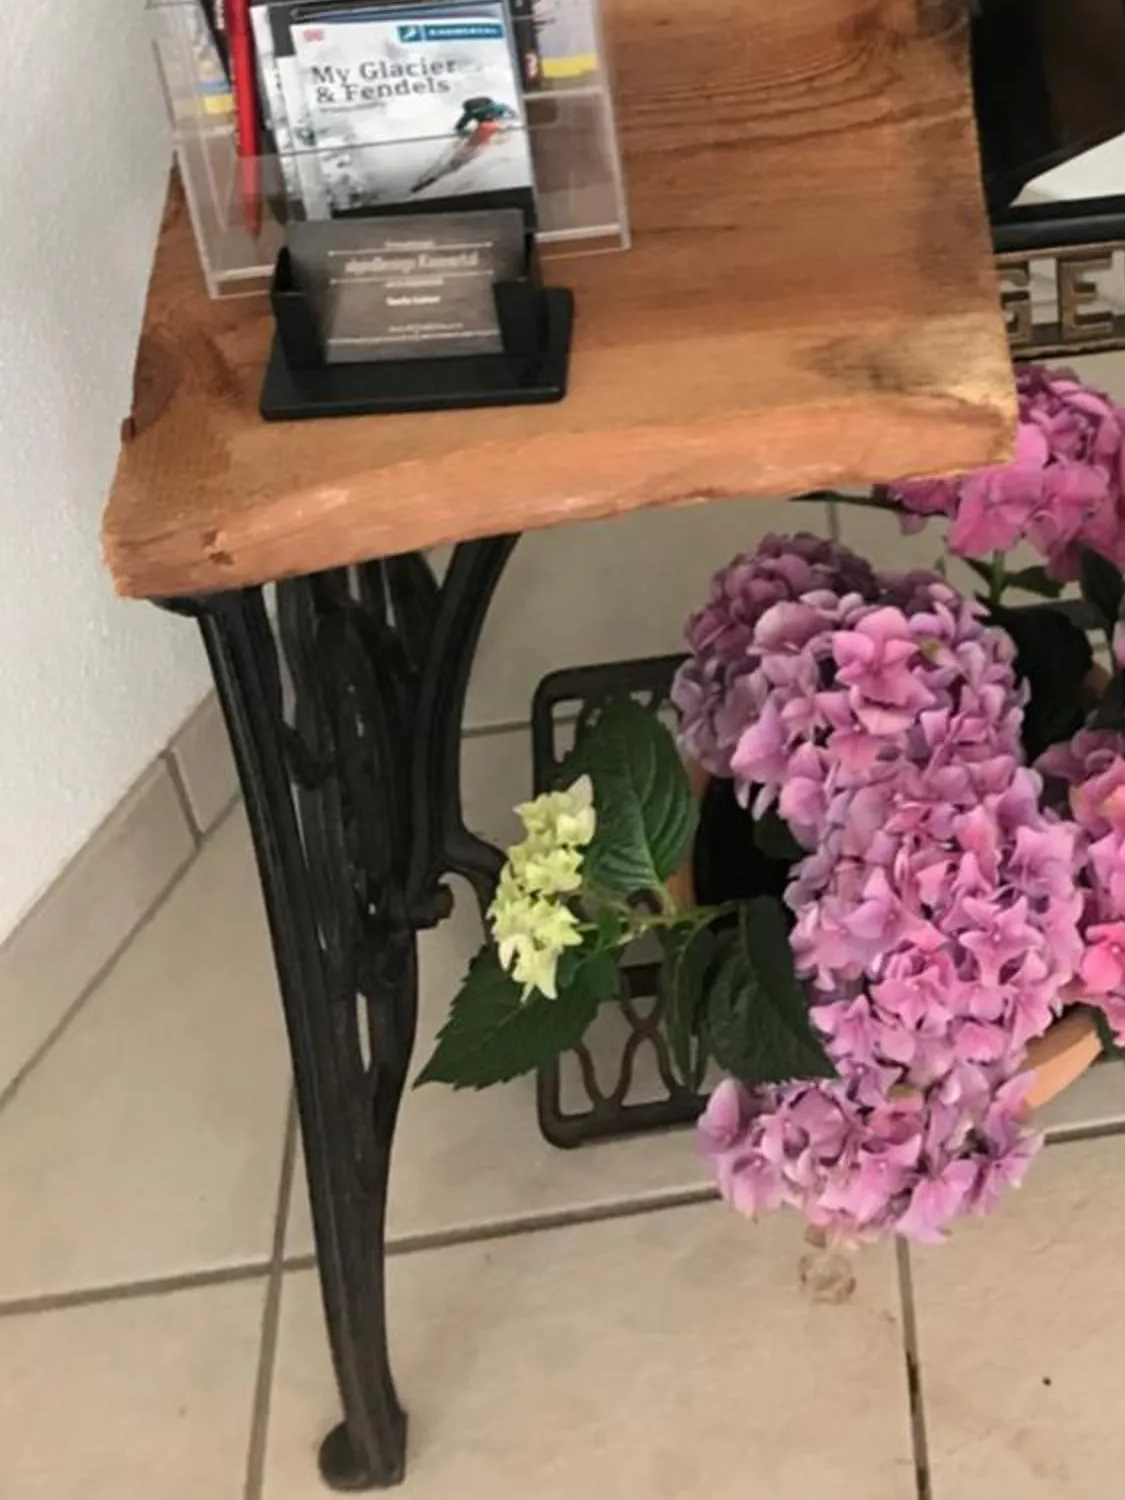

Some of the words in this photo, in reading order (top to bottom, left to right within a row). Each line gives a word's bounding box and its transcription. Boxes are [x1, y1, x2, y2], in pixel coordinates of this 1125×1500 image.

[310, 64, 351, 85] My
[358, 56, 457, 81] Glacier
[315, 86, 336, 103] &
[343, 76, 451, 101] Fendels
